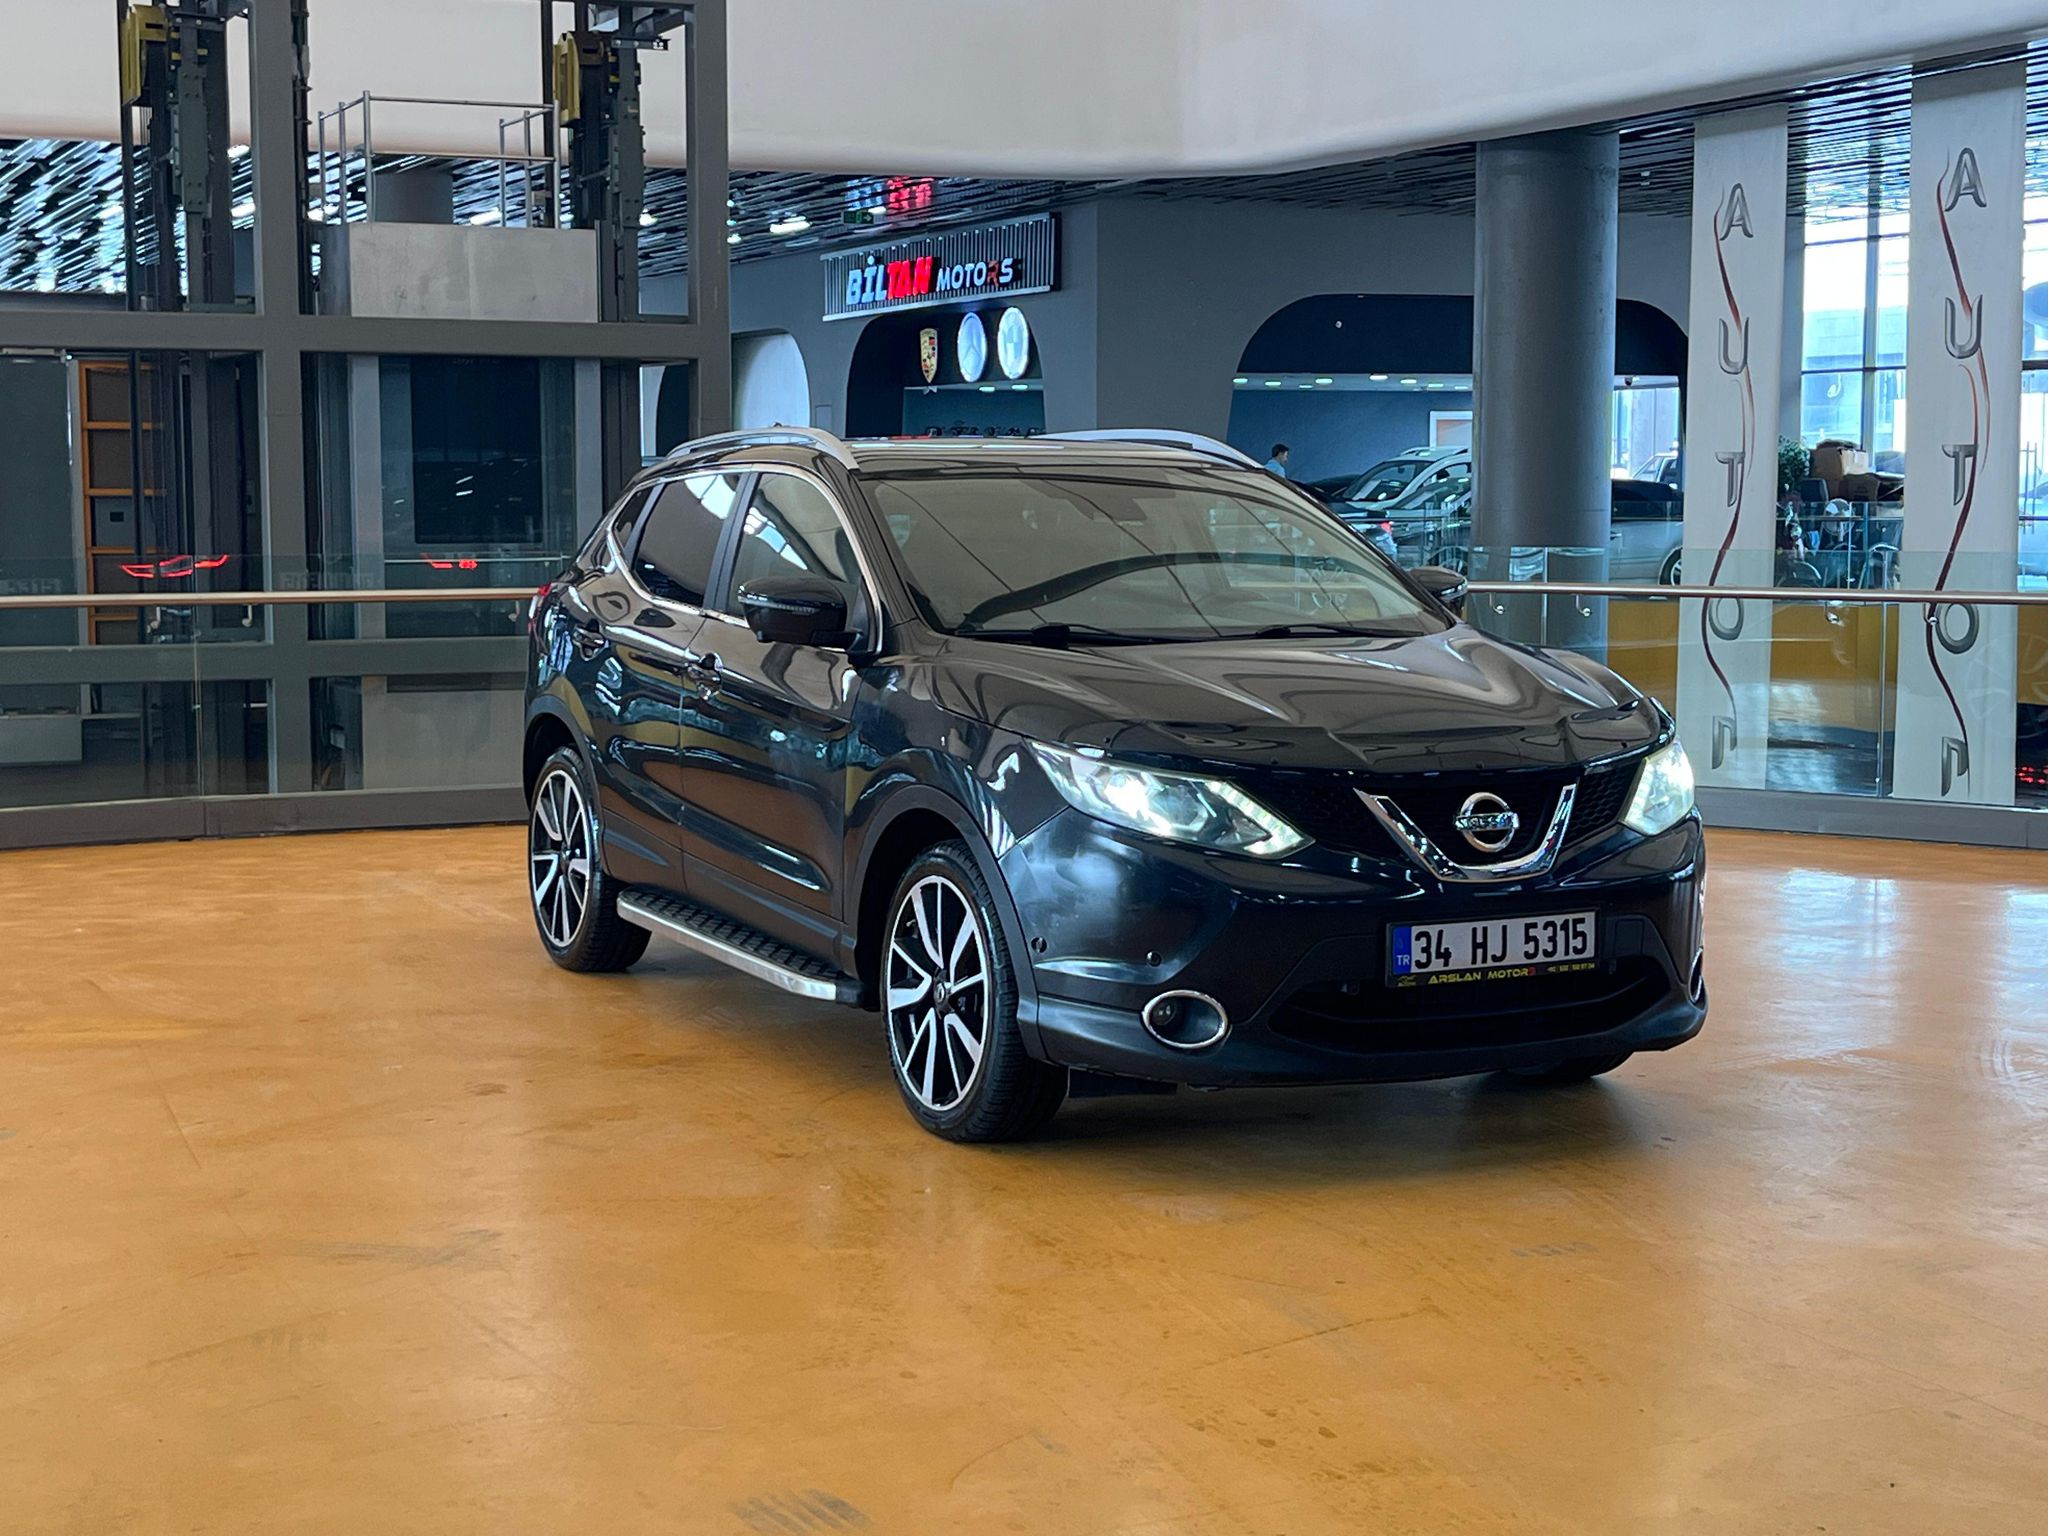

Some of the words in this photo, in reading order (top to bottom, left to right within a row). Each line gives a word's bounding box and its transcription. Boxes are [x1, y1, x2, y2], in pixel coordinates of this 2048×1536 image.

[846, 255, 933, 305] BİLTAN
[936, 257, 1014, 292] MOTORS
[1414, 929, 1452, 969] 34
[1471, 925, 1508, 965] HJ
[1523, 917, 1588, 960] 5315
[1396, 954, 1410, 966] TR
[1428, 971, 1482, 985] ARSLAN
